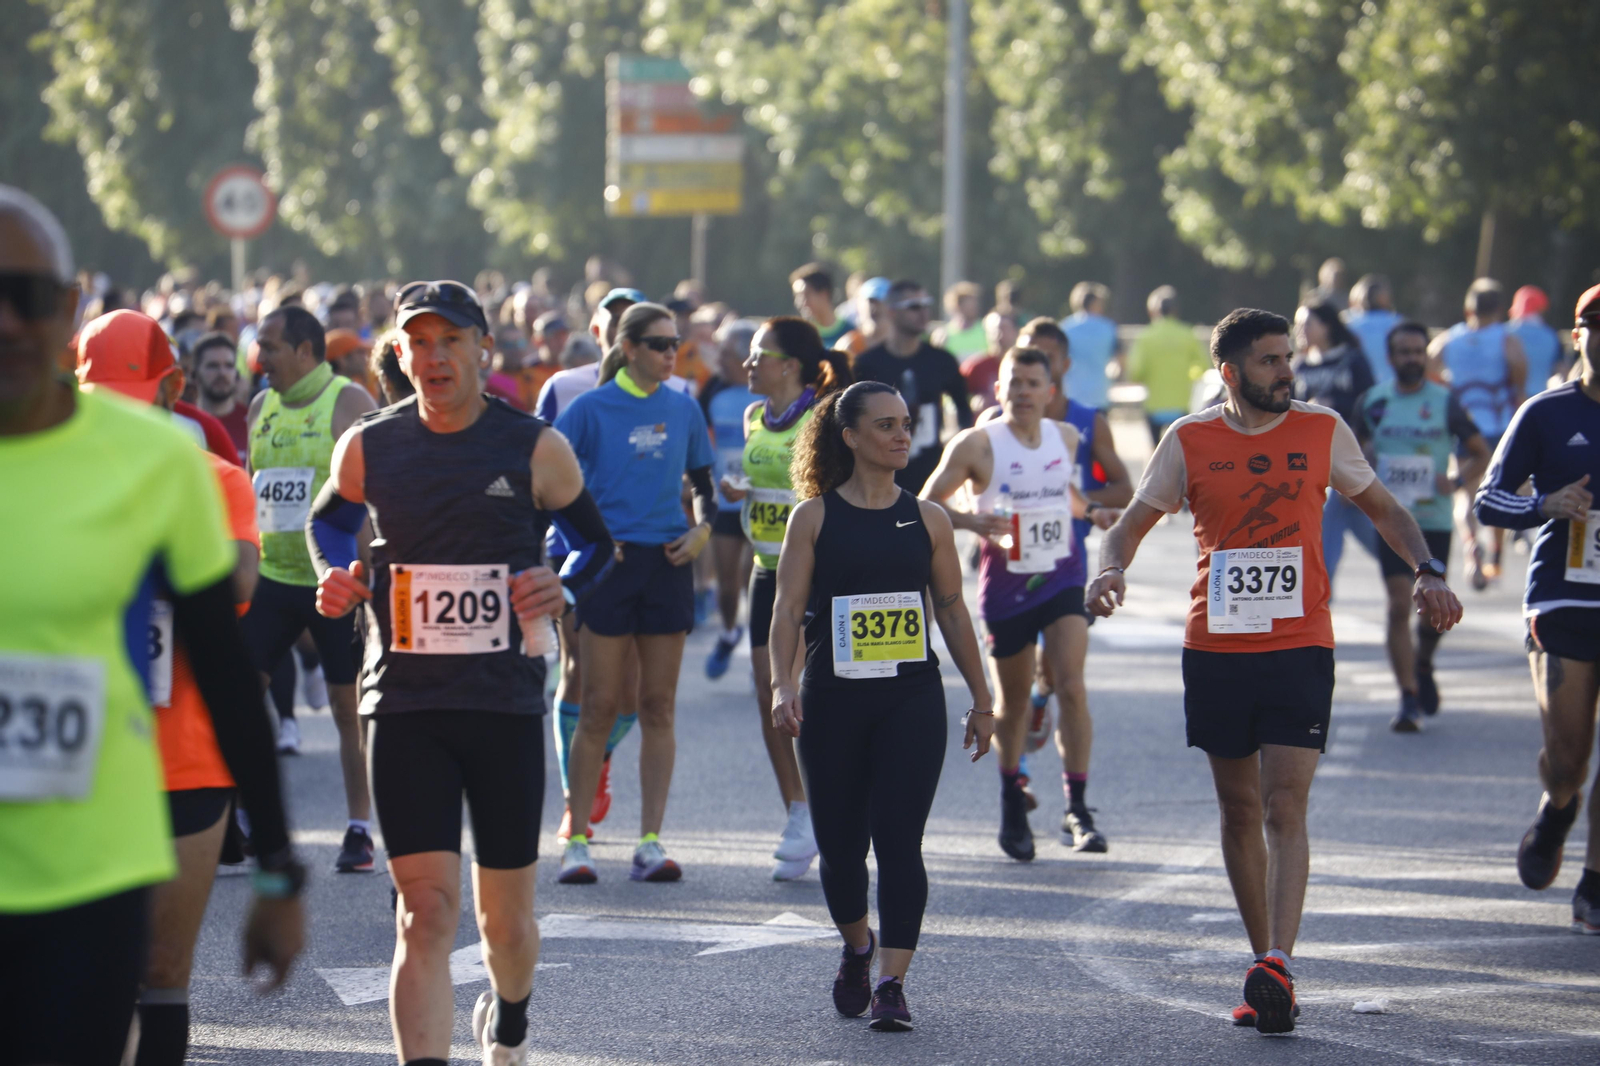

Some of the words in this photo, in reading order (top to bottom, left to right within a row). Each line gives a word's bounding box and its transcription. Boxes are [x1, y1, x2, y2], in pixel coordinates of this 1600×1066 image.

[260, 481, 306, 502] 4623
[749, 502, 790, 525] 4134
[1029, 520, 1062, 543] 160
[1247, 537, 1269, 549] ENO
[1270, 520, 1300, 546] VIRTUAL
[1237, 551, 1274, 559] IMDECO
[1213, 574, 1222, 602] CAJÓN
[1227, 565, 1297, 594] 3379
[414, 590, 501, 624] 1209
[860, 596, 896, 605] IMDECO
[838, 620, 846, 648] CAJÓN
[851, 609, 920, 640] 3378
